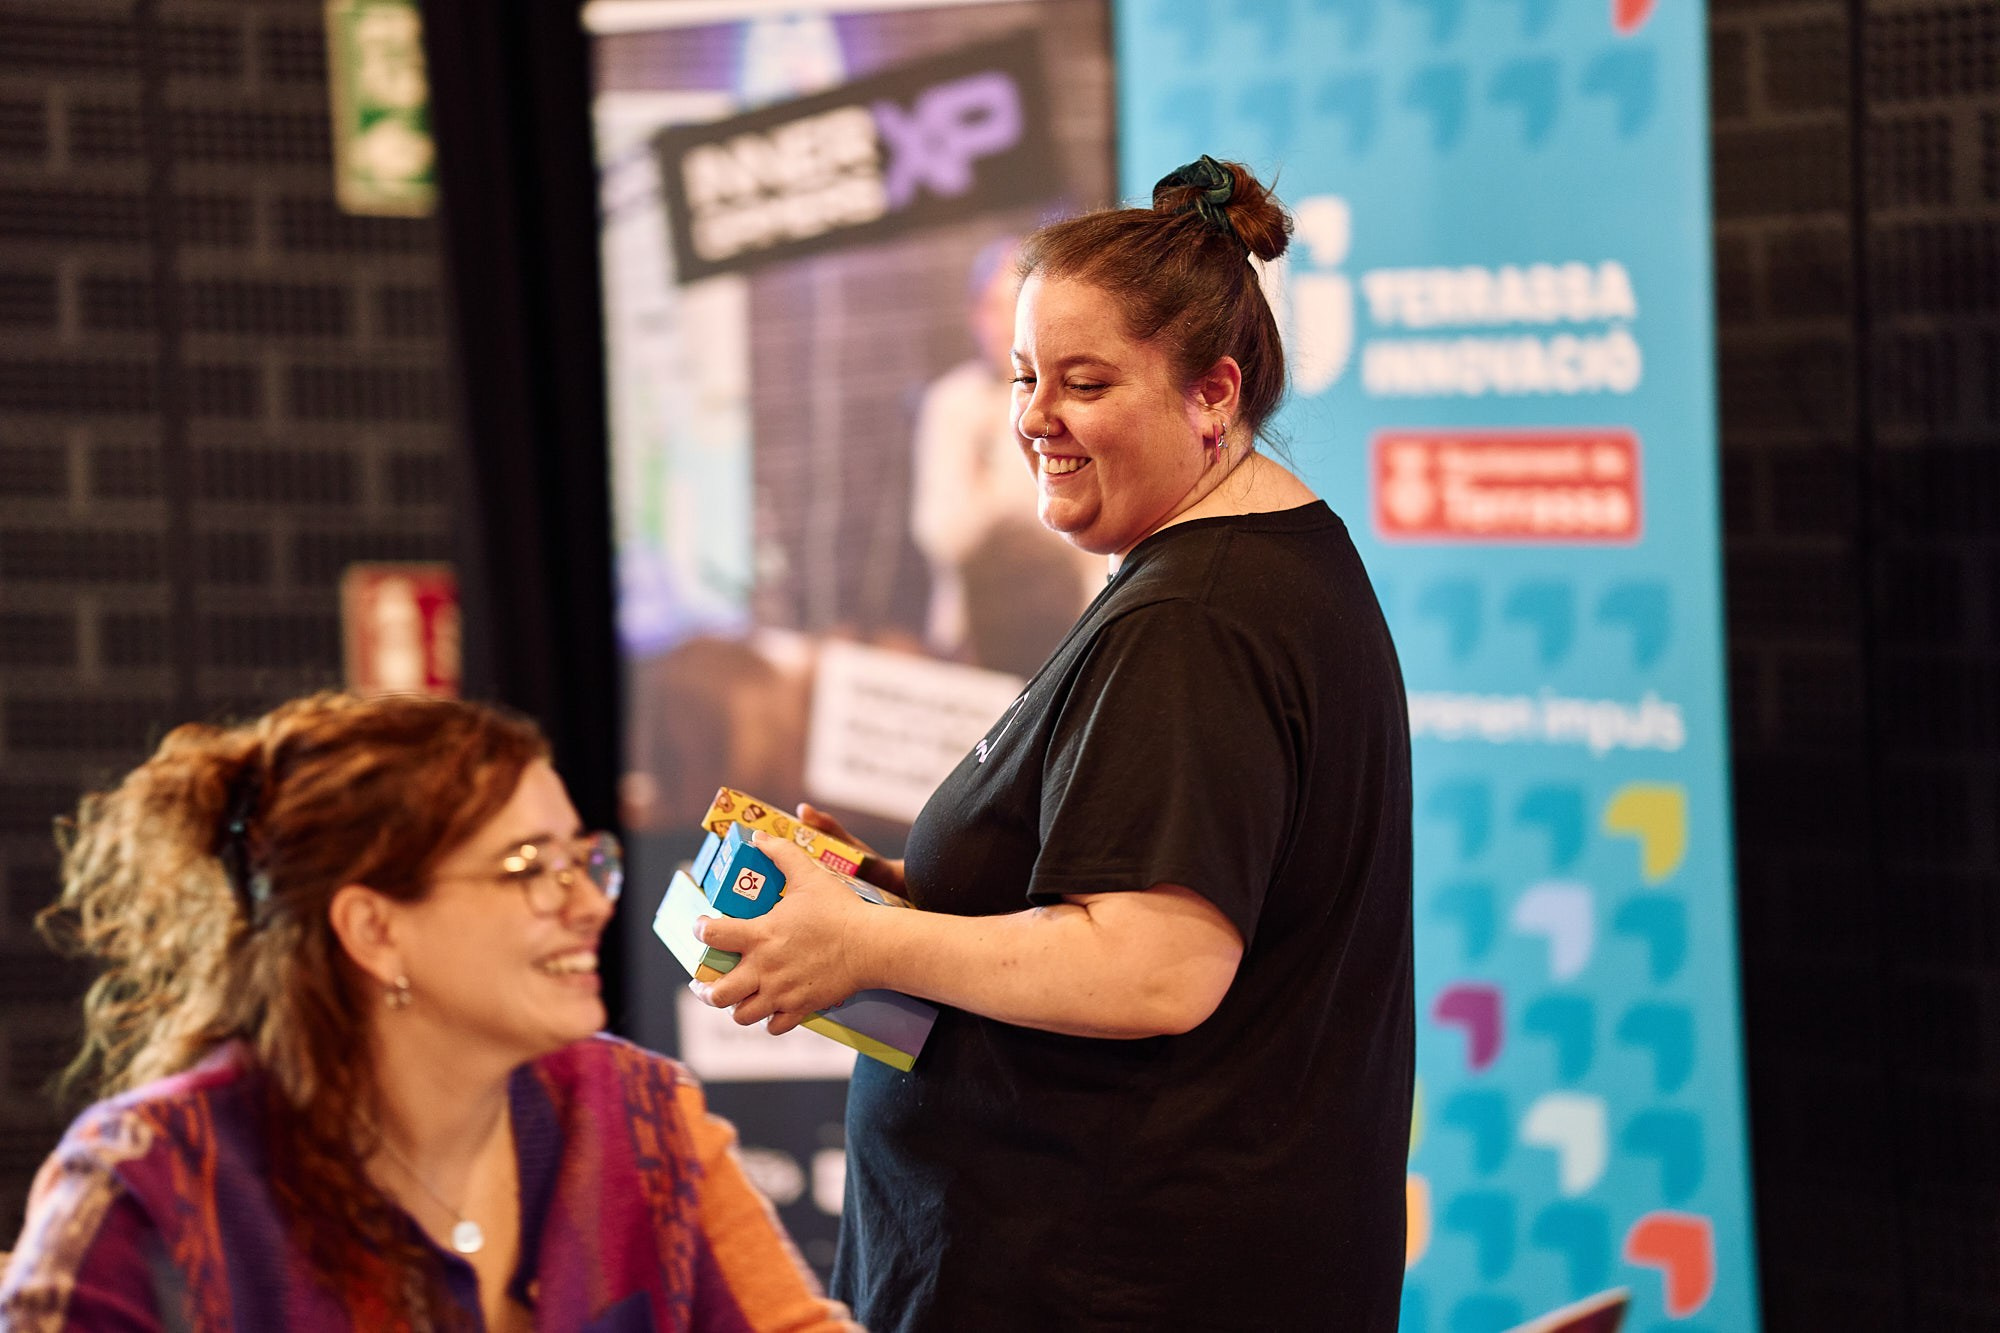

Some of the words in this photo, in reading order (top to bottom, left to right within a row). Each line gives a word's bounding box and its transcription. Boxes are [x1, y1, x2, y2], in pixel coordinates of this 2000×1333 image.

[1363, 260, 1637, 328] TERRASSA
[1361, 326, 1642, 396] INNOVACIÓ
[1540, 686, 1685, 759] impuls
